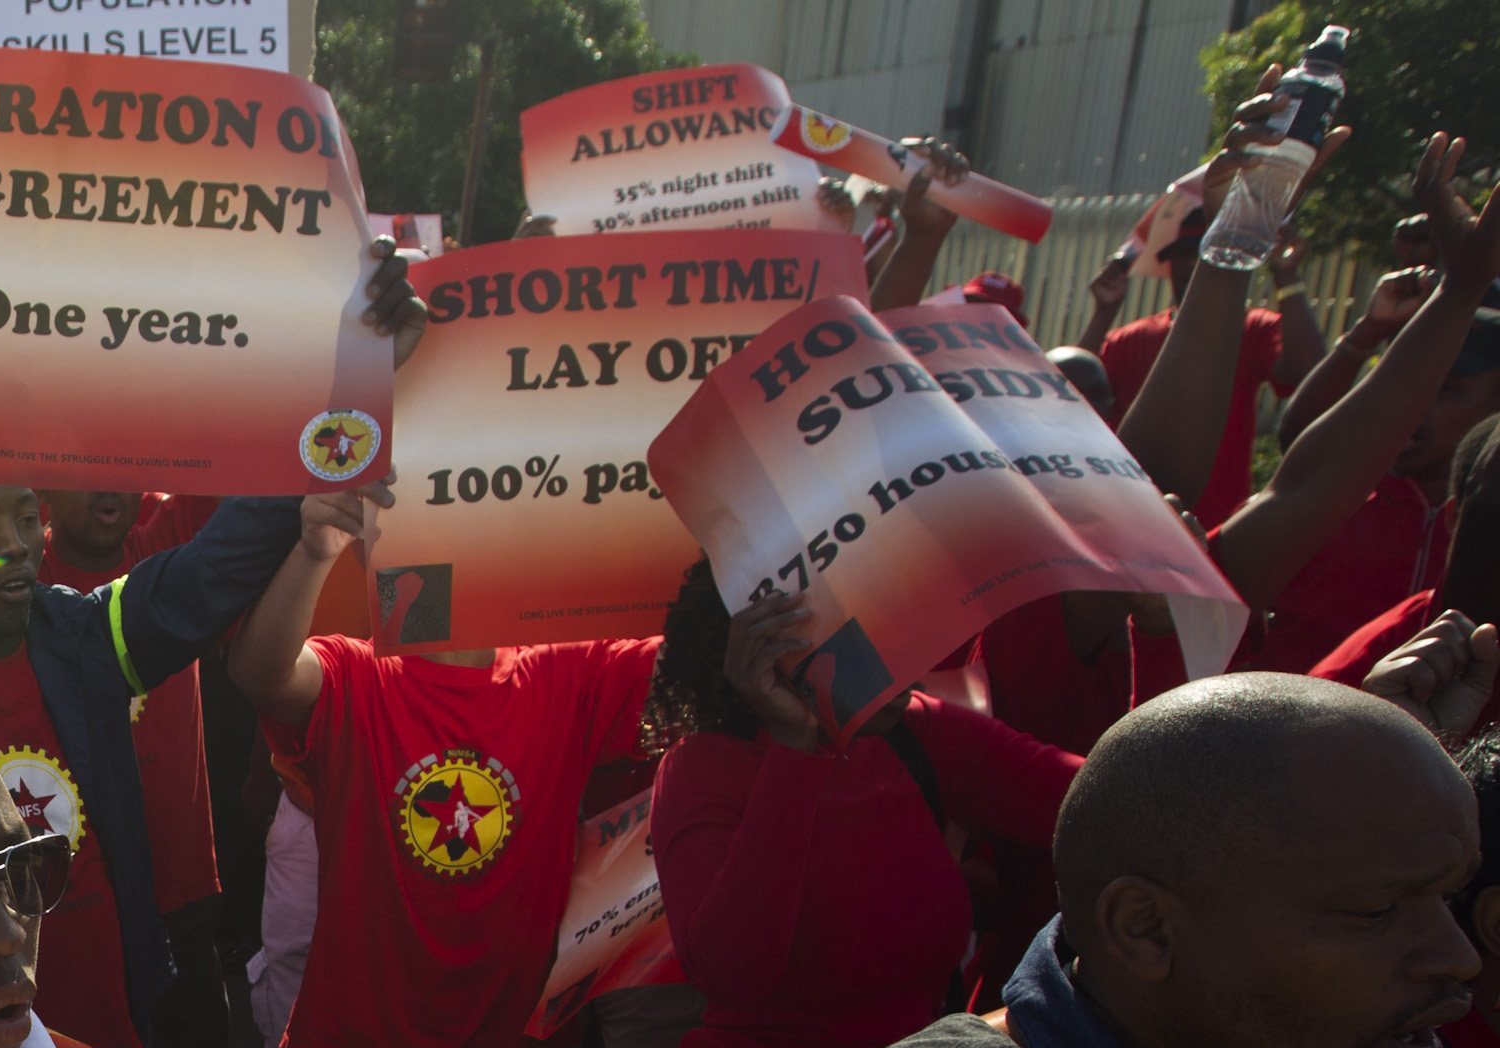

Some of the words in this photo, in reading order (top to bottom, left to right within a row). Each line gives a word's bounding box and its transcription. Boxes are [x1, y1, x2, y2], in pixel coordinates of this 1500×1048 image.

[138, 26, 248, 57] LEVEL
[260, 26, 277, 55] 5
[632, 73, 739, 113] SHIFT
[614, 179, 656, 204] 35%
[662, 169, 719, 195] night
[725, 161, 775, 184] shift
[640, 195, 747, 225] afternoon
[752, 185, 801, 207] shift
[427, 262, 647, 324] SHORT
[660, 257, 821, 305] TIME/
[100, 306, 249, 350] year.
[506, 340, 633, 391] LAY
[17, 450, 37, 461] LIVE
[39, 452, 57, 462] THE
[60, 454, 112, 465] STRUGGLE
[114, 456, 133, 465] FOR
[136, 457, 169, 467] LIVING
[425, 453, 569, 505] 100%
